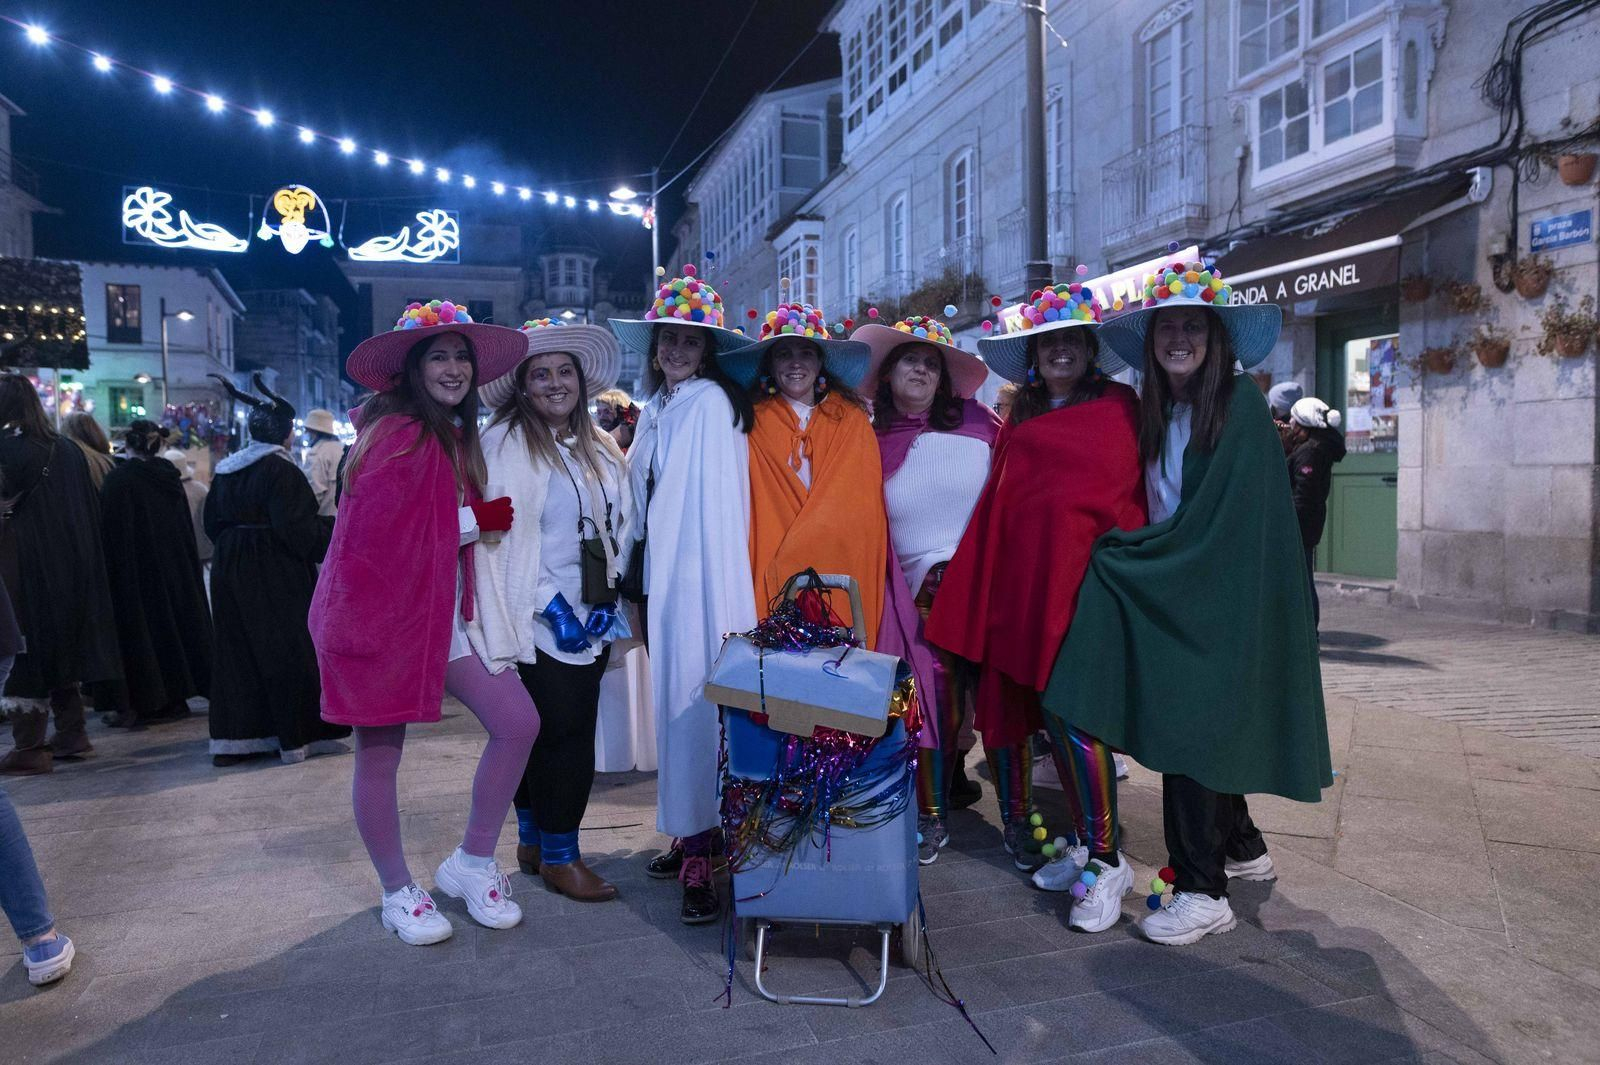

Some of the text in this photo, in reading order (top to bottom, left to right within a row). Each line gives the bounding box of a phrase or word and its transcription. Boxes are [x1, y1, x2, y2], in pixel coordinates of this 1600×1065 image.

[1548, 220, 1573, 234] praza
[1559, 226, 1590, 241] Barbón
[1275, 280, 1287, 300] A
[1294, 264, 1361, 295] GRANEL
